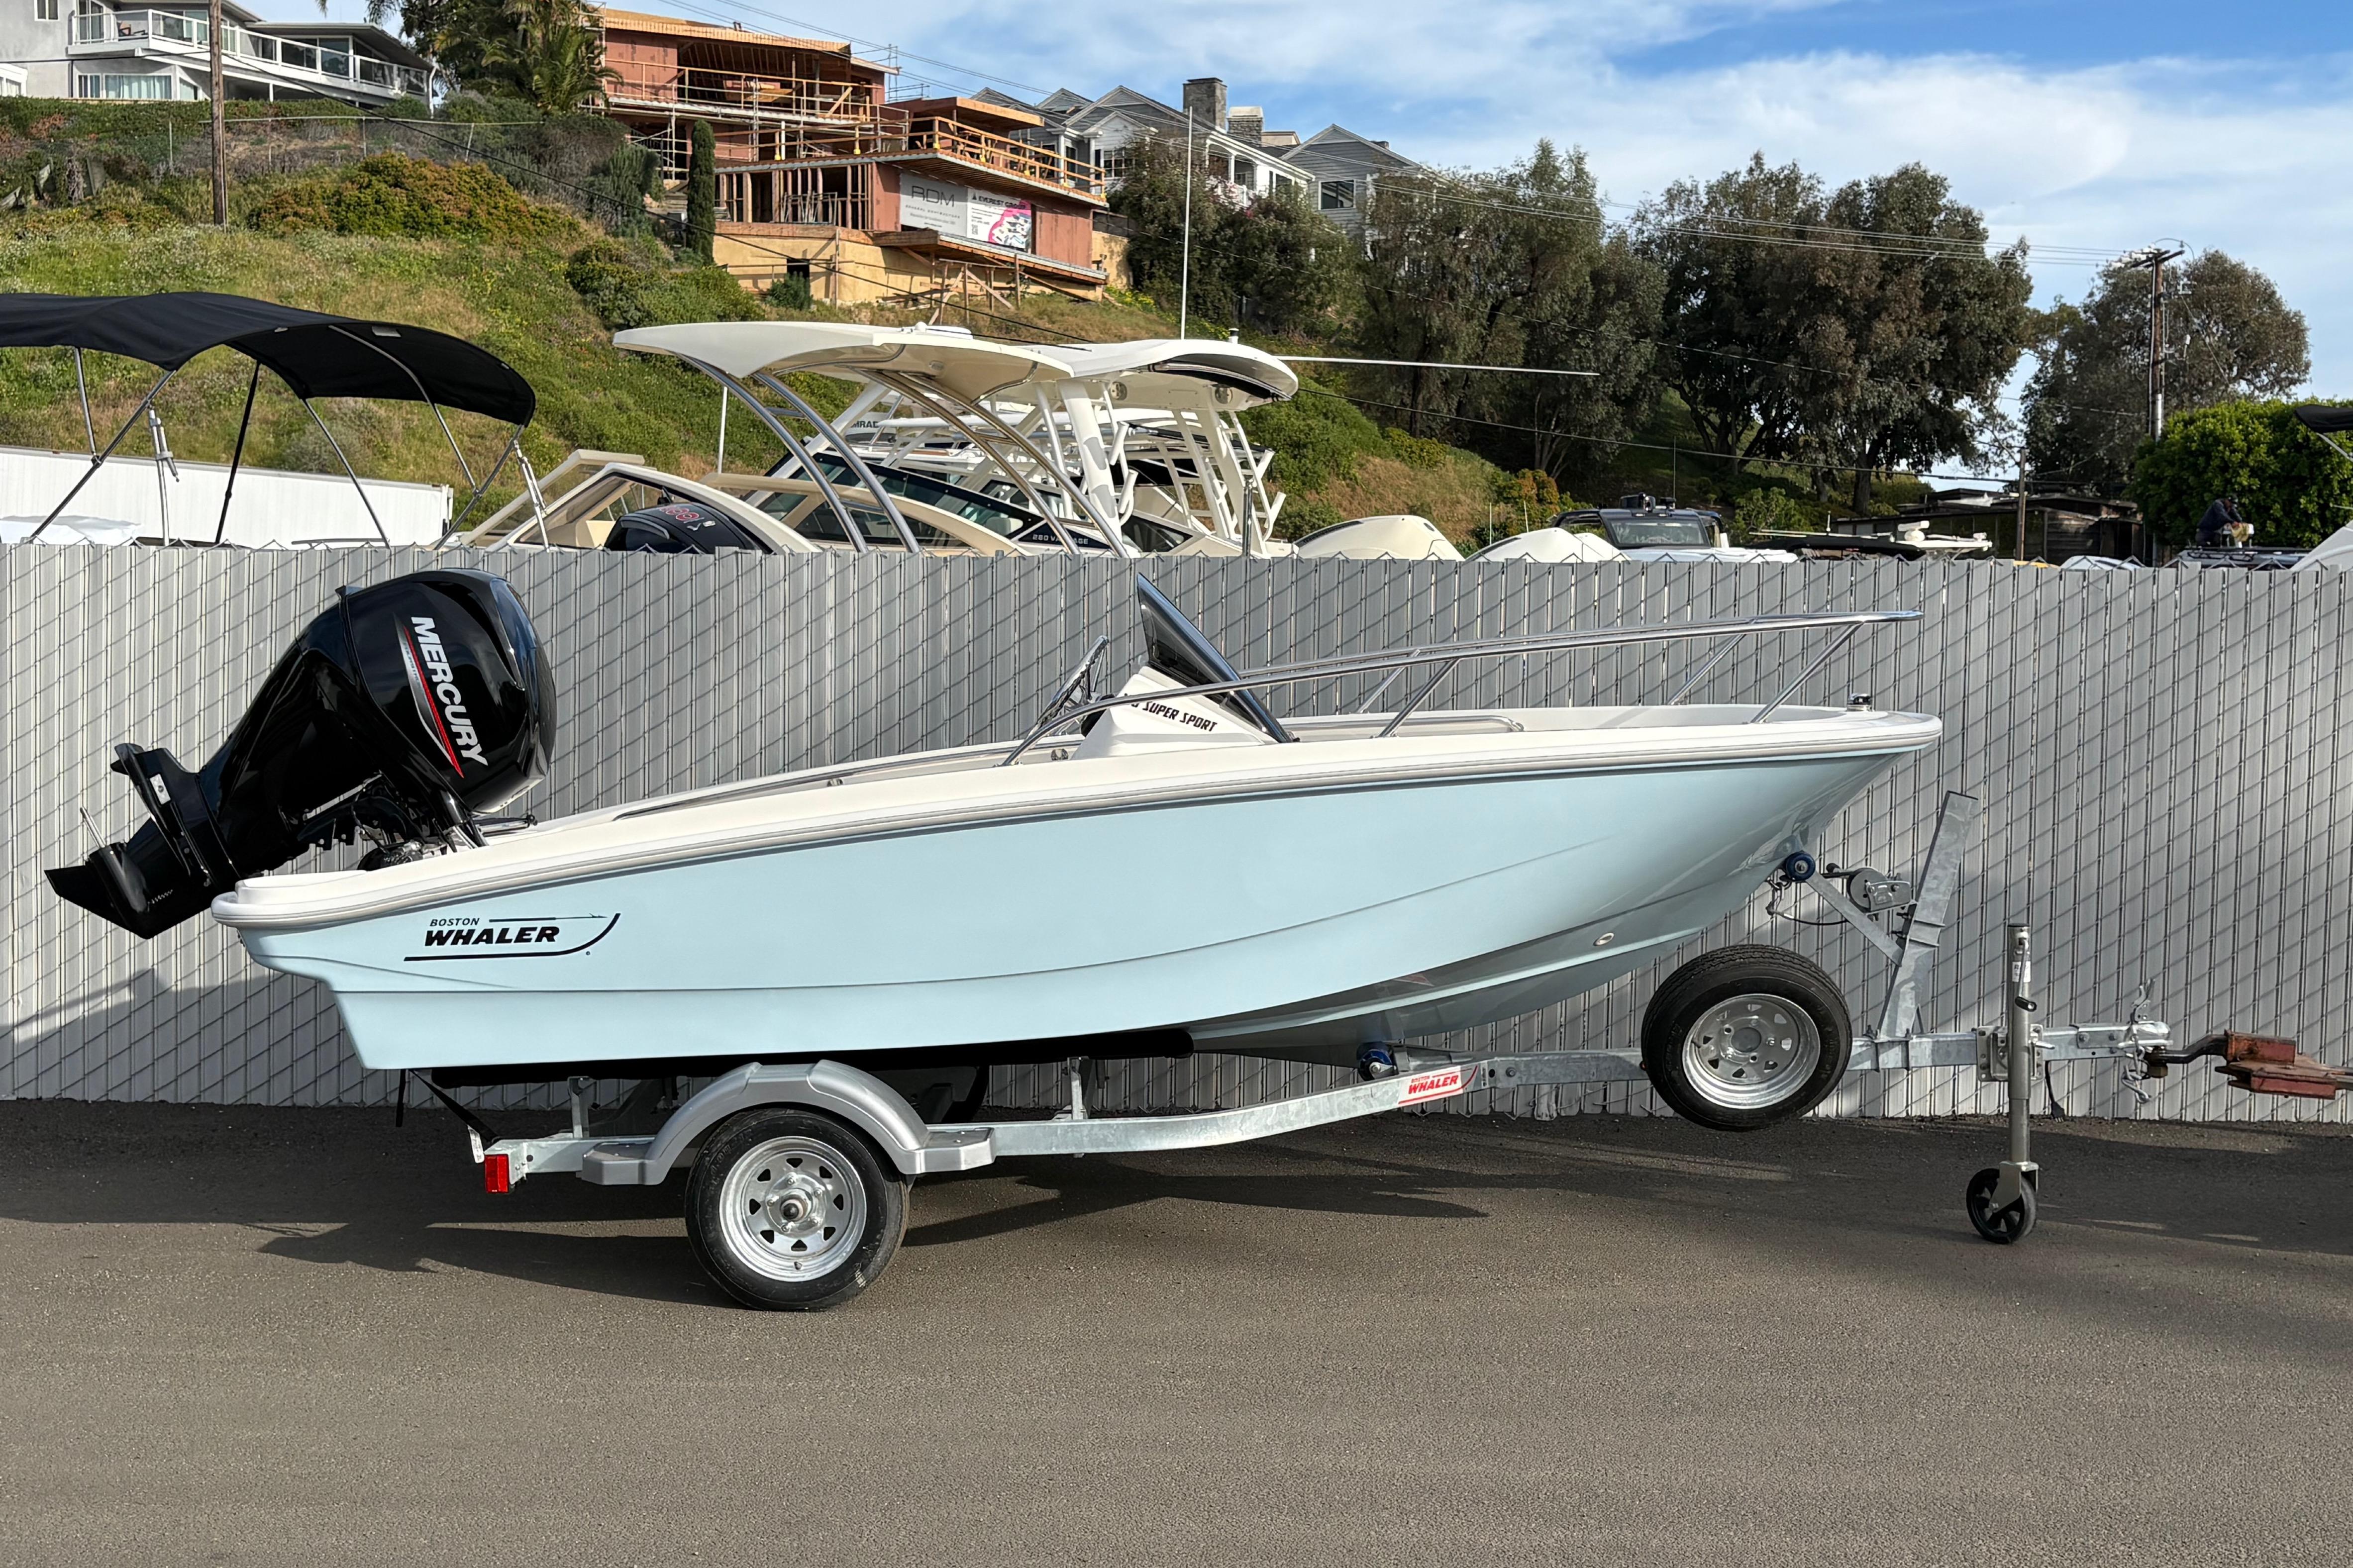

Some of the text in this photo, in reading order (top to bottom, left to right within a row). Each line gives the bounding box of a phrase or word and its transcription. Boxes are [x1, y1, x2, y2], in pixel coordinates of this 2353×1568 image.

[911, 185, 954, 207] RDM
[411, 616, 489, 767] MERCURY
[1142, 701, 1218, 732] SUPER SPORT
[429, 917, 480, 927] BOSTON
[424, 926, 560, 947] WHALER
[1408, 1075, 1459, 1094] WHALER
